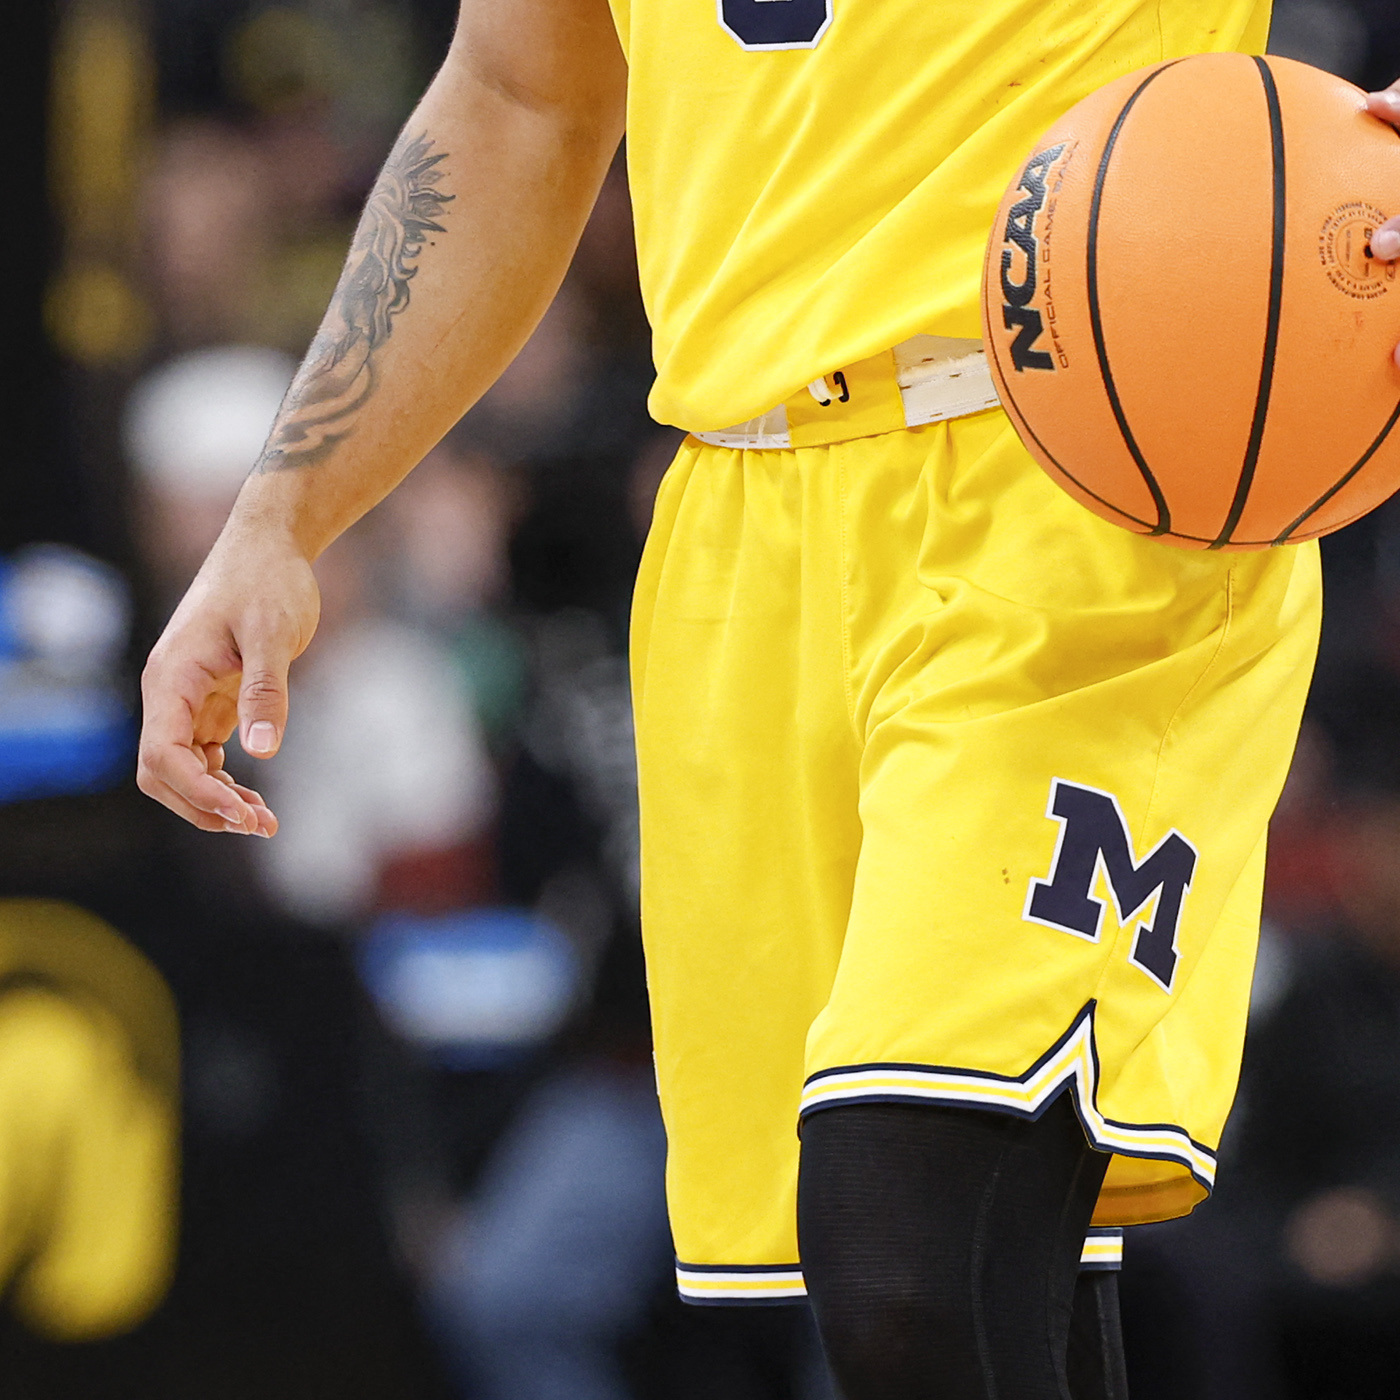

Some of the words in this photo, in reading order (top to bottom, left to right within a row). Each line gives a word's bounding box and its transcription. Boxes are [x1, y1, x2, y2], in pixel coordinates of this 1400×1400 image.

[1000, 143, 1067, 373] NCAA
[1043, 198, 1058, 263] GAME
[1043, 268, 1069, 369] OFFICIAL
[1021, 776, 1200, 995] M
